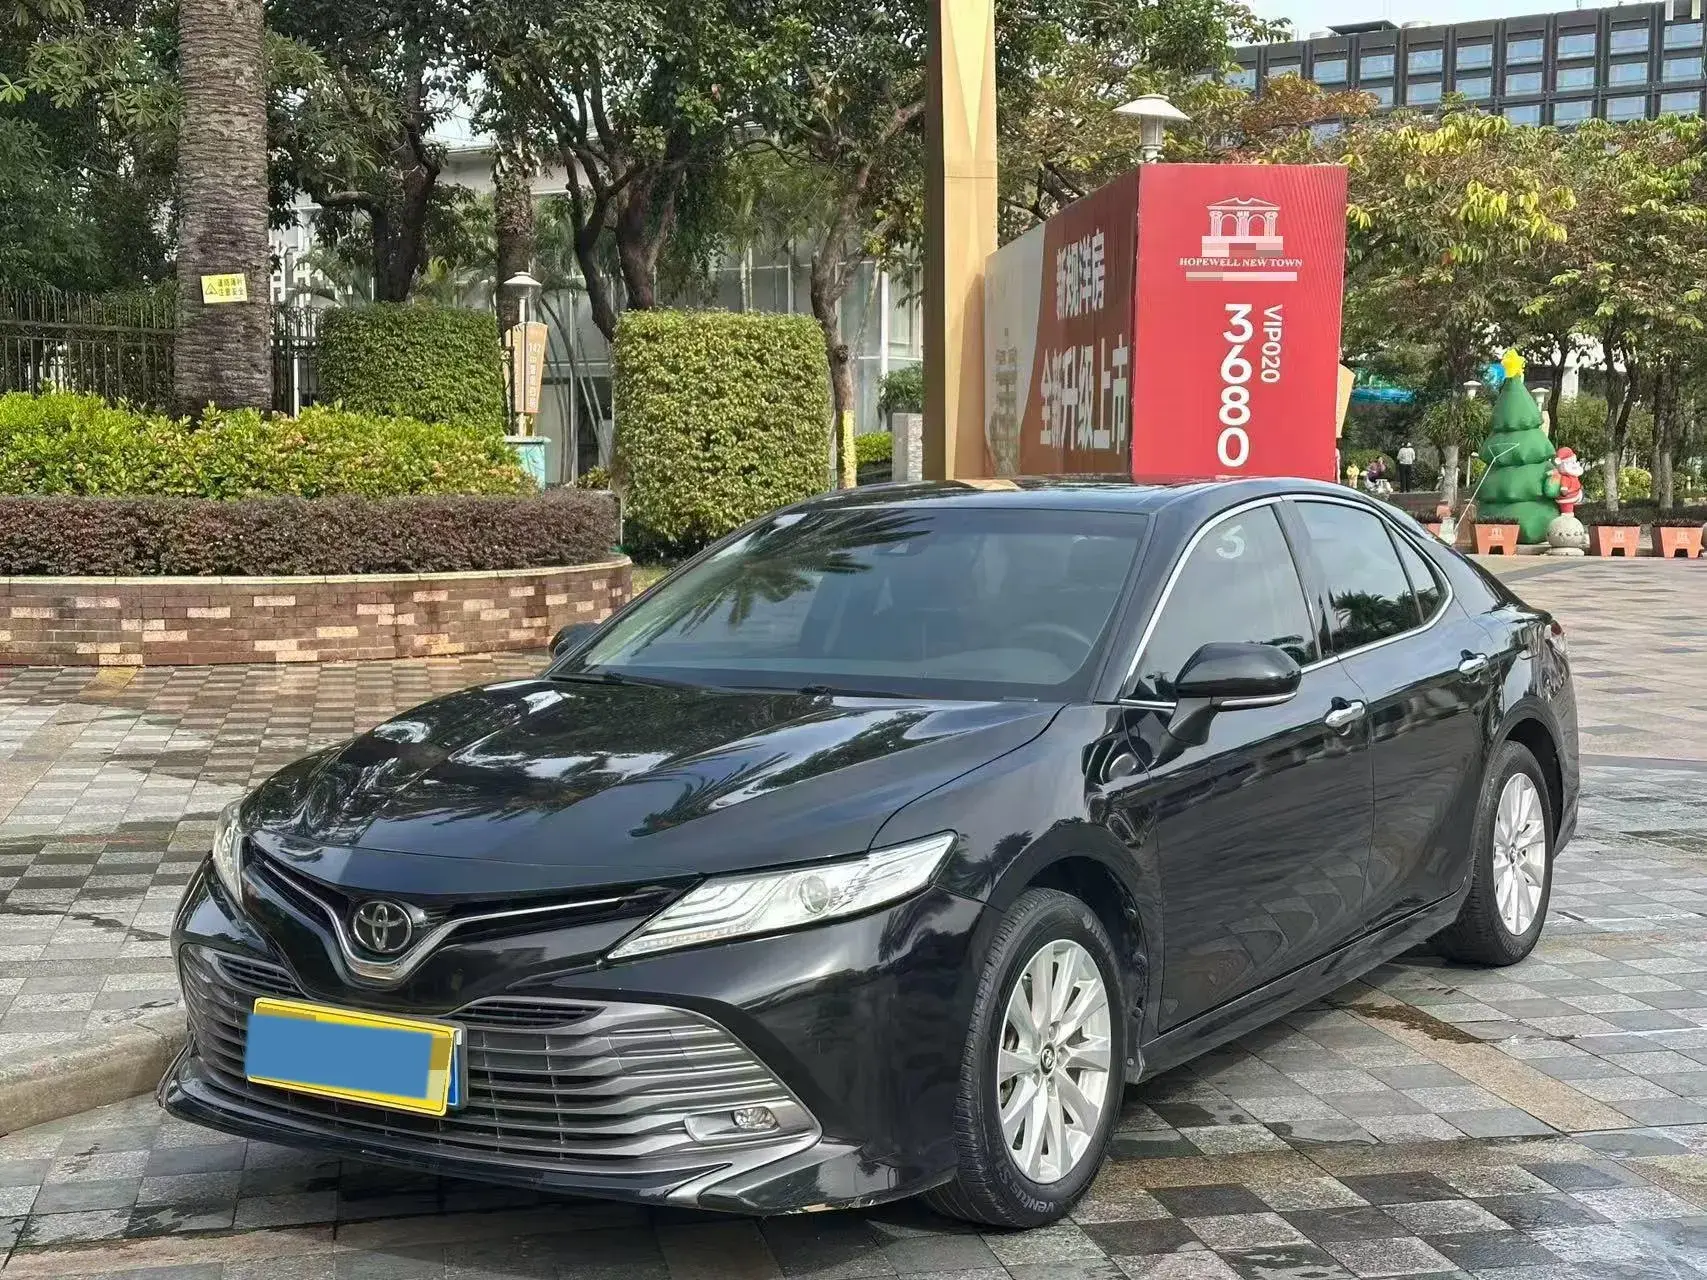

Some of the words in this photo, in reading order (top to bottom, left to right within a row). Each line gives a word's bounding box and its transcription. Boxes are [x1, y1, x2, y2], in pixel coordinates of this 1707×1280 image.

[1180, 257, 1240, 267] HOPEWELL
[1242, 258, 1267, 267] NEW
[1269, 259, 1303, 268] TOWN
[1040, 333, 1128, 455] 全新升级上市
[1217, 303, 1254, 468] 3680
[1260, 303, 1283, 384] VIP020
